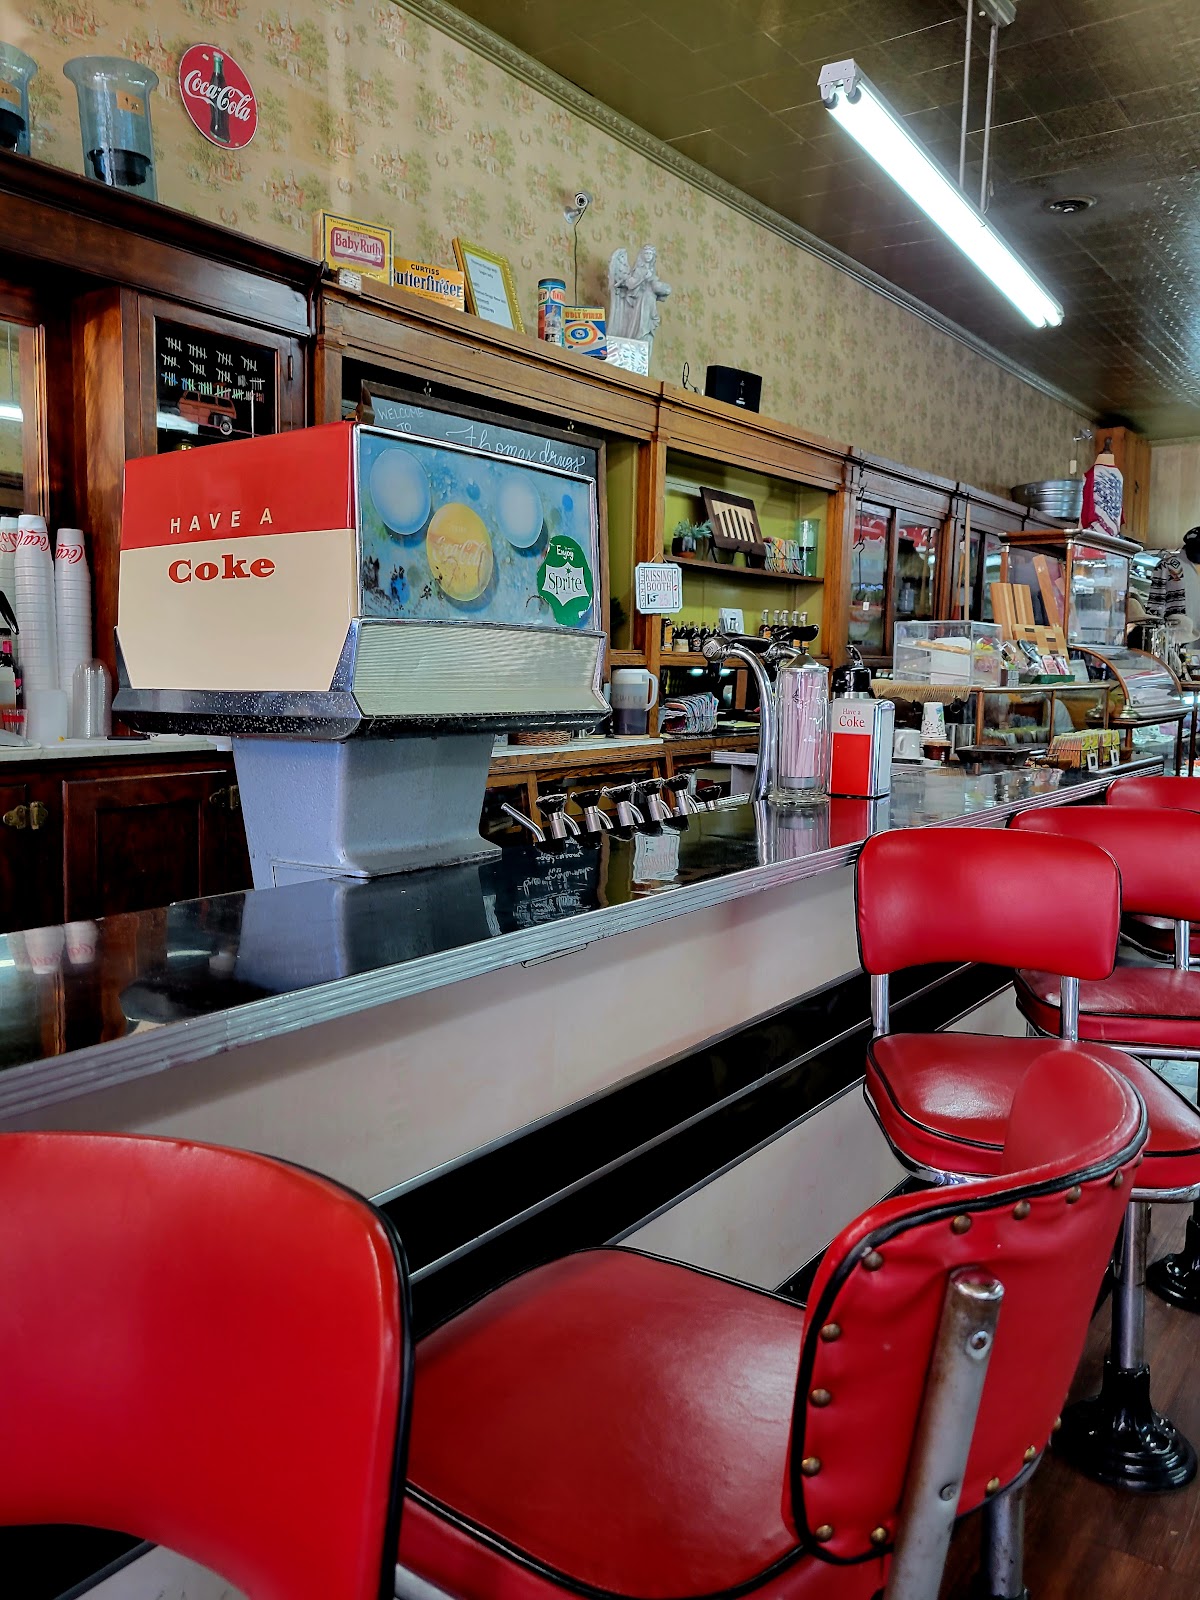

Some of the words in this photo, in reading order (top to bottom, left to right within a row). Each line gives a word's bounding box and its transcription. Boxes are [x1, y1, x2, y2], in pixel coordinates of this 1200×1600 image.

[184, 69, 253, 121] Coca-Cola
[410, 263, 440, 276] CURTISS
[378, 406, 424, 421] WELCOME
[397, 423, 412, 433] TO
[539, 440, 586, 472] drugs
[169, 510, 241, 534] HAVE
[259, 507, 273, 525] A
[556, 544, 574, 561] Enjoy
[168, 554, 276, 584] Coke
[645, 569, 672, 582] KISSING
[548, 572, 582, 595] Sprite
[647, 582, 672, 591] BOOTH
[839, 715, 866, 728] Coke
